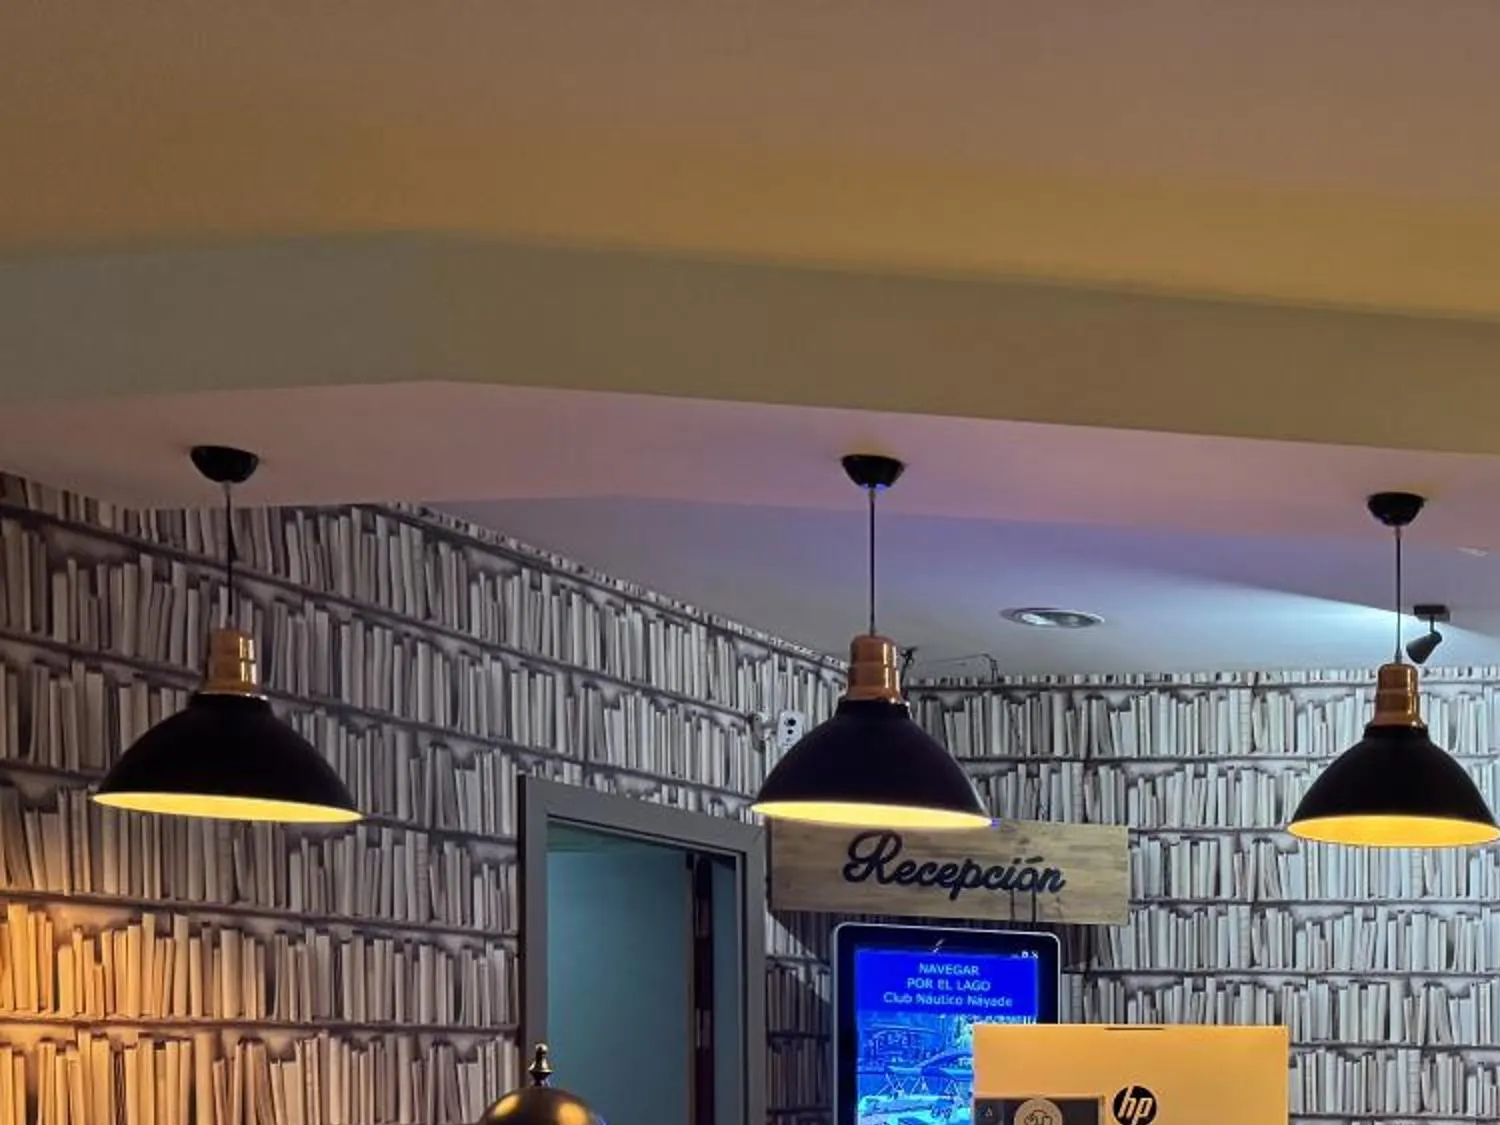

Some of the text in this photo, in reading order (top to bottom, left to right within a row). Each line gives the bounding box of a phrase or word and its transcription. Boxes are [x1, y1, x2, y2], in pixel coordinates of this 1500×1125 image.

[842, 829, 1066, 900] Recepción
[919, 962, 980, 976] NAVEGAR
[907, 977, 991, 993] POR EL LAGO
[883, 991, 912, 1003] Club
[915, 992, 963, 1006] Náutico
